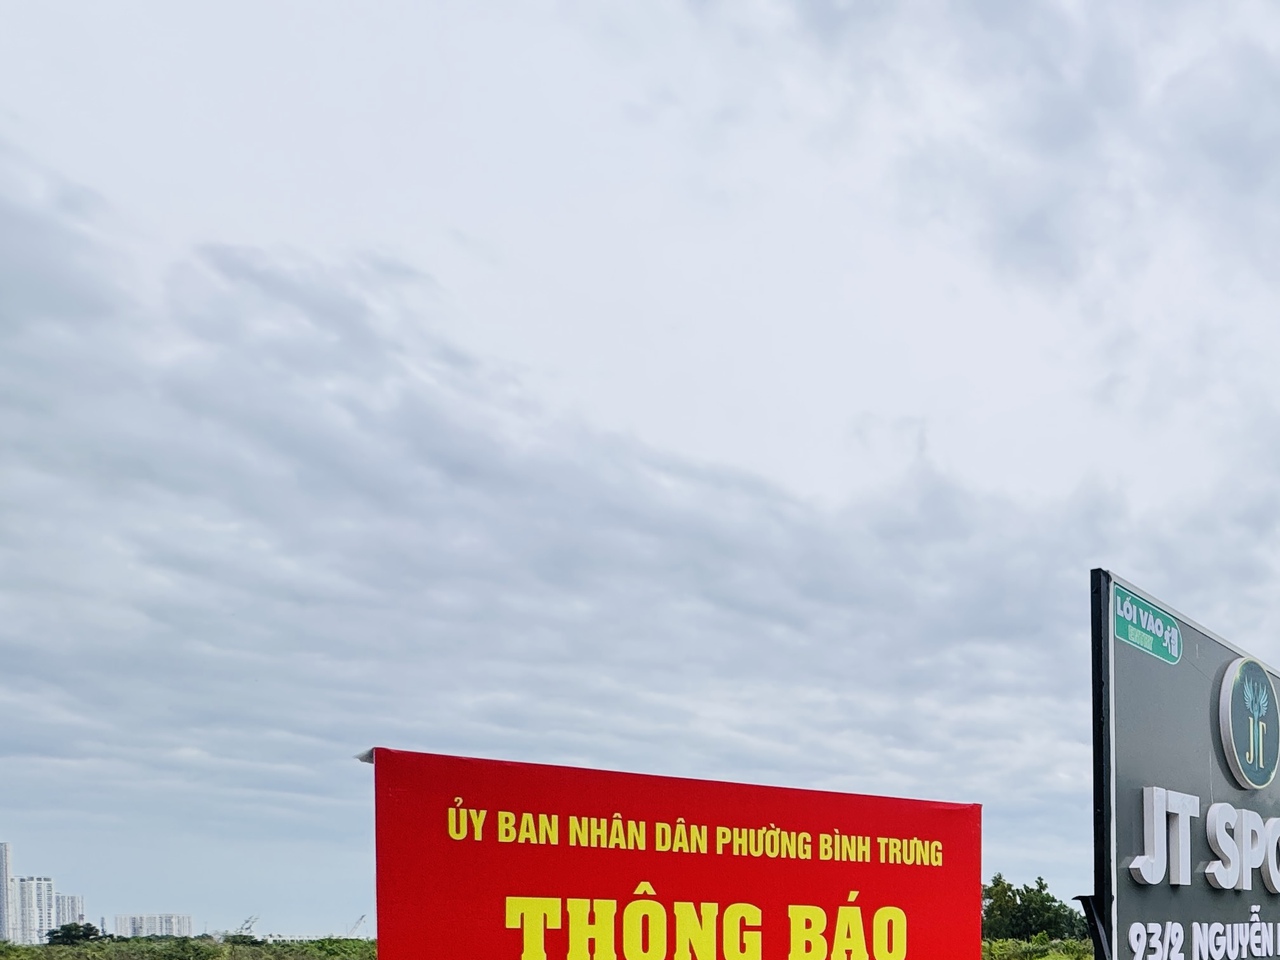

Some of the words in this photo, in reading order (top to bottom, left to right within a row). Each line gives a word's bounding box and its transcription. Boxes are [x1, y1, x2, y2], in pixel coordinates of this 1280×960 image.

[1116, 595, 1137, 625] LỐI
[1139, 609, 1164, 638] VÀO
[448, 796, 488, 841] ỦY
[497, 810, 559, 846] BAN
[569, 812, 646, 851] NHÂN
[655, 817, 708, 854] DÂN
[716, 823, 812, 860] PHƯỜNG
[819, 828, 871, 863] BÌNH
[876, 836, 943, 867] TRƯNG
[1128, 786, 1200, 886] JT
